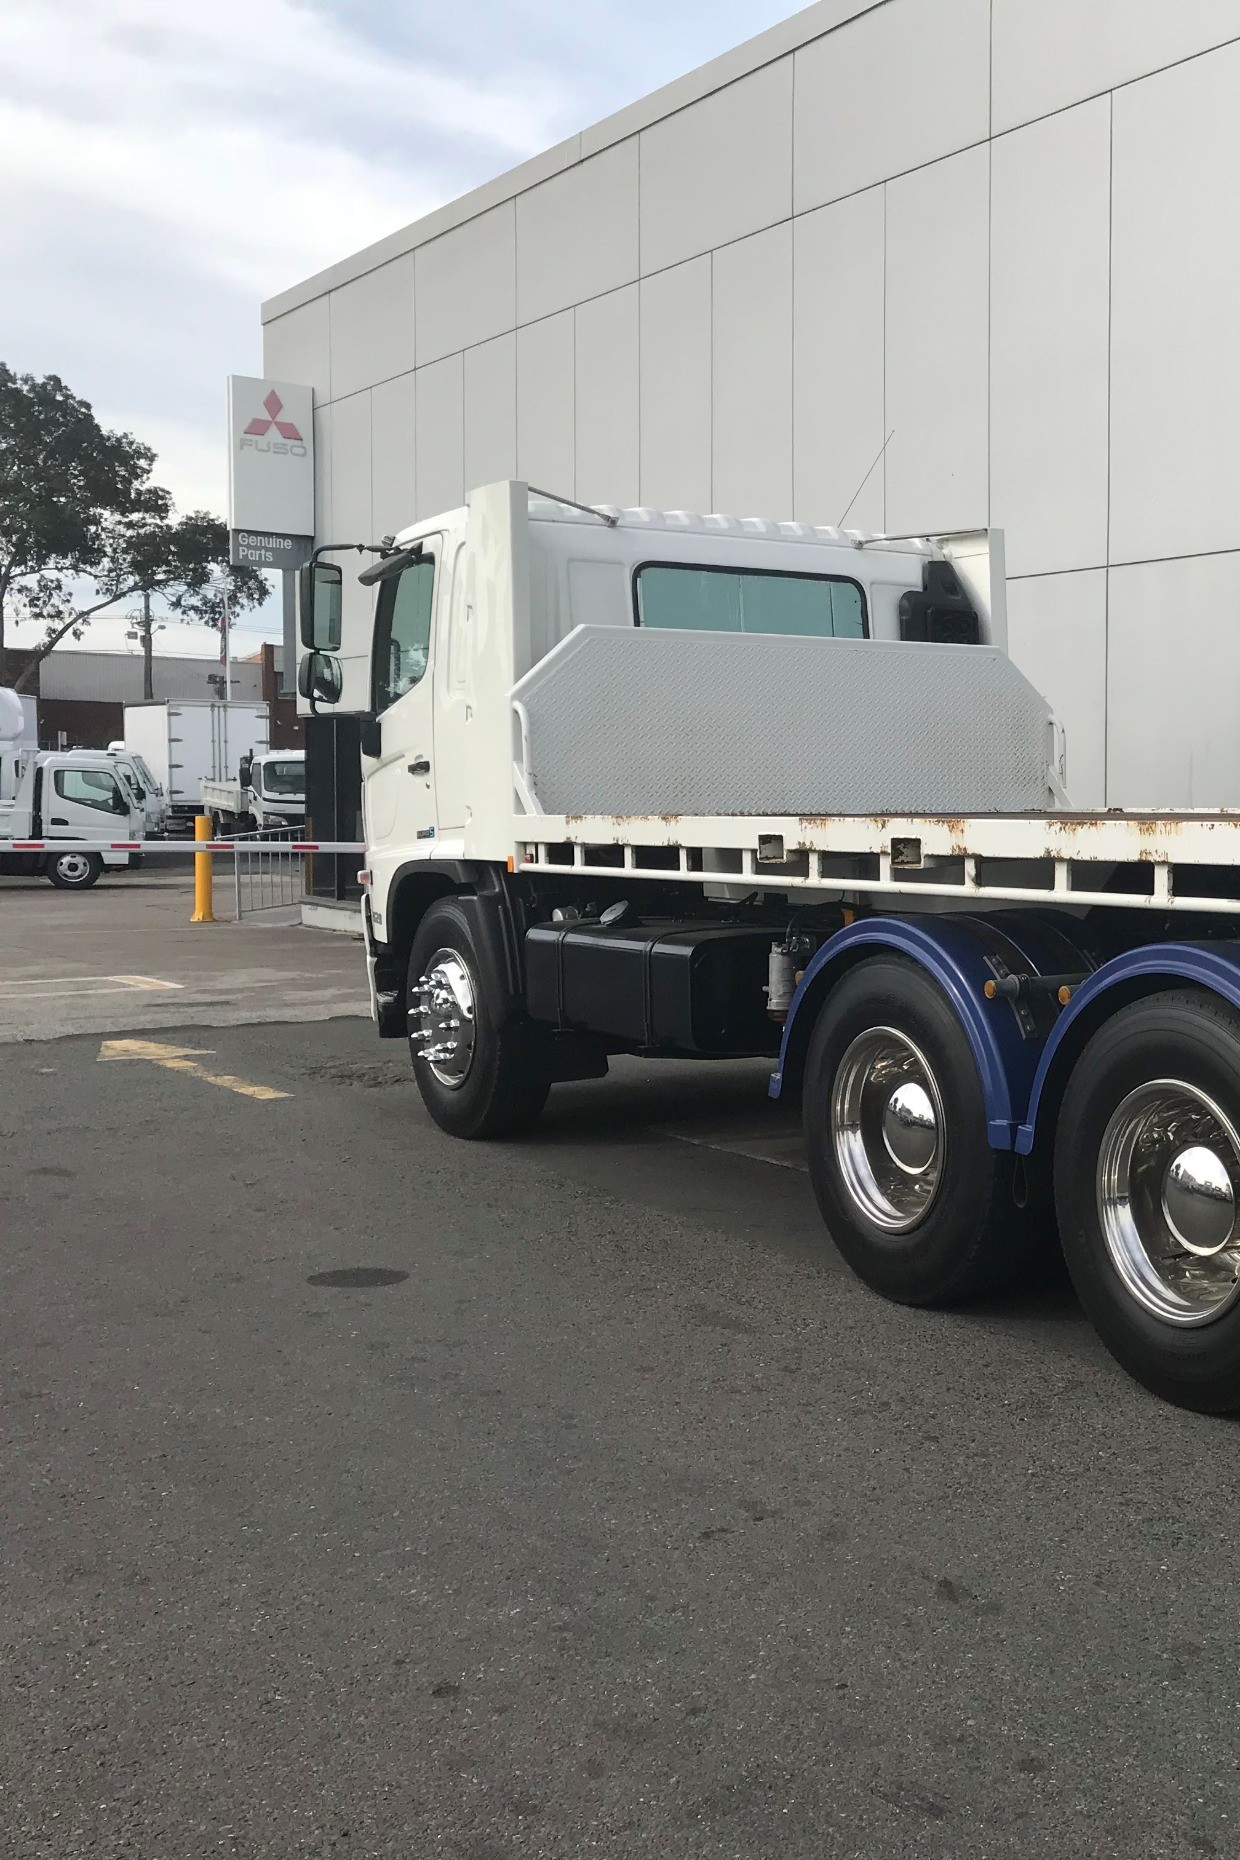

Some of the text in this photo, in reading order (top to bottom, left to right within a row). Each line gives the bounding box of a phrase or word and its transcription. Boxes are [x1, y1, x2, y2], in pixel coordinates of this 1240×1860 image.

[239, 438, 307, 457] FUSO
[238, 532, 292, 549] Genuine
[238, 546, 273, 562] Parts
